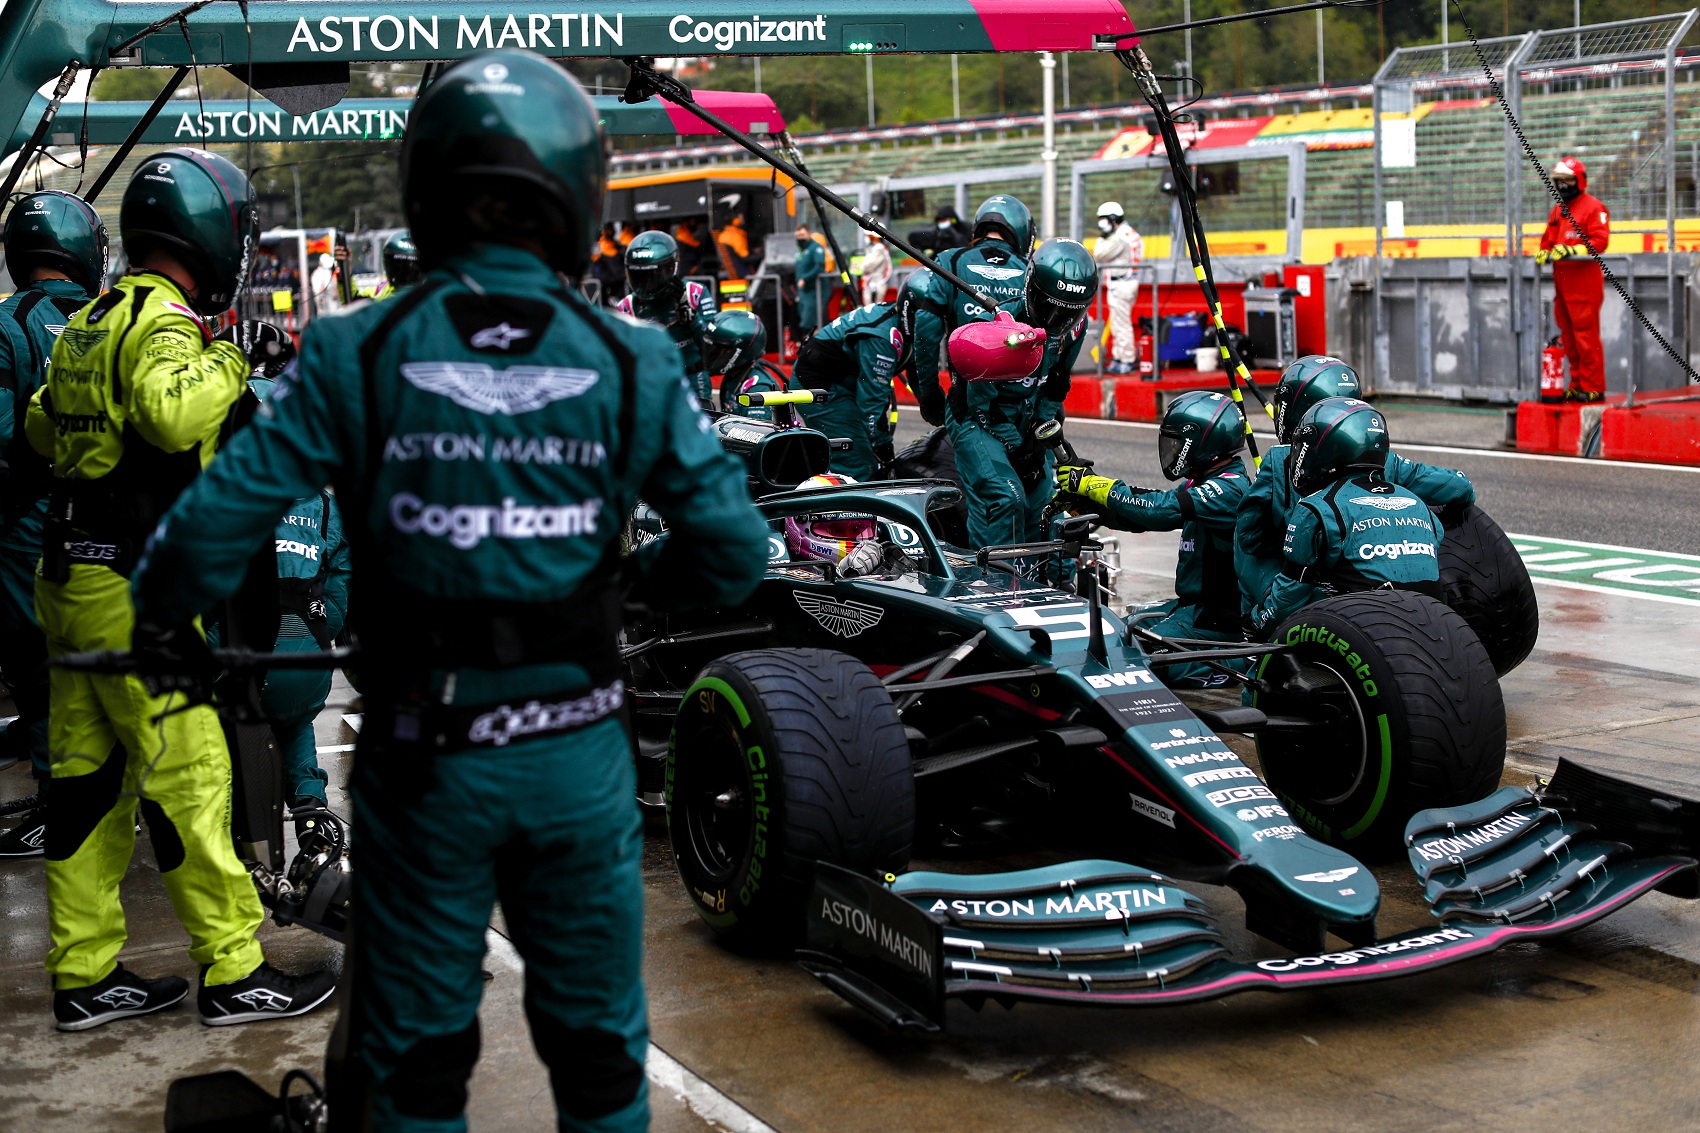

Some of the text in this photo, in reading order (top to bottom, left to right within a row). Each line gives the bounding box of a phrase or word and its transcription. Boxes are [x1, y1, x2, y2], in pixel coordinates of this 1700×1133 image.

[286, 12, 624, 53] ASTON MARTIN
[668, 14, 827, 52] Cognizant
[174, 109, 409, 138] ASTON MARTIN
[1065, 284, 1087, 295] BWT
[1047, 297, 1087, 310] ASTON MARTIN
[382, 431, 608, 468] ASTON MARTIN
[1171, 437, 1193, 477] Cognizant
[1122, 492, 1156, 508] MARTIN
[389, 491, 603, 551] Cognizant
[1351, 517, 1432, 533] ASTON MARTIN
[816, 545, 833, 556] BWT
[820, 602, 861, 620] ASTON MARTIN
[1286, 622, 1379, 698] Cinturato
[1083, 669, 1155, 689] BWT
[699, 690, 716, 714] SV
[1133, 698, 1157, 706] HRH
[1150, 735, 1222, 751] SentinelOne
[1164, 750, 1239, 769] NetApp
[1182, 766, 1258, 788] PIRELLI
[1214, 785, 1272, 804] JCB
[1133, 797, 1172, 822] RAVENOL
[1255, 804, 1290, 819] IFS
[739, 745, 770, 906] Cinturato
[1415, 810, 1532, 863] ASTON MARTIN
[929, 886, 1167, 917] ASTON MARTIN
[821, 897, 933, 980] ASTON MARTIN
[1256, 927, 1475, 972] Cognizant
